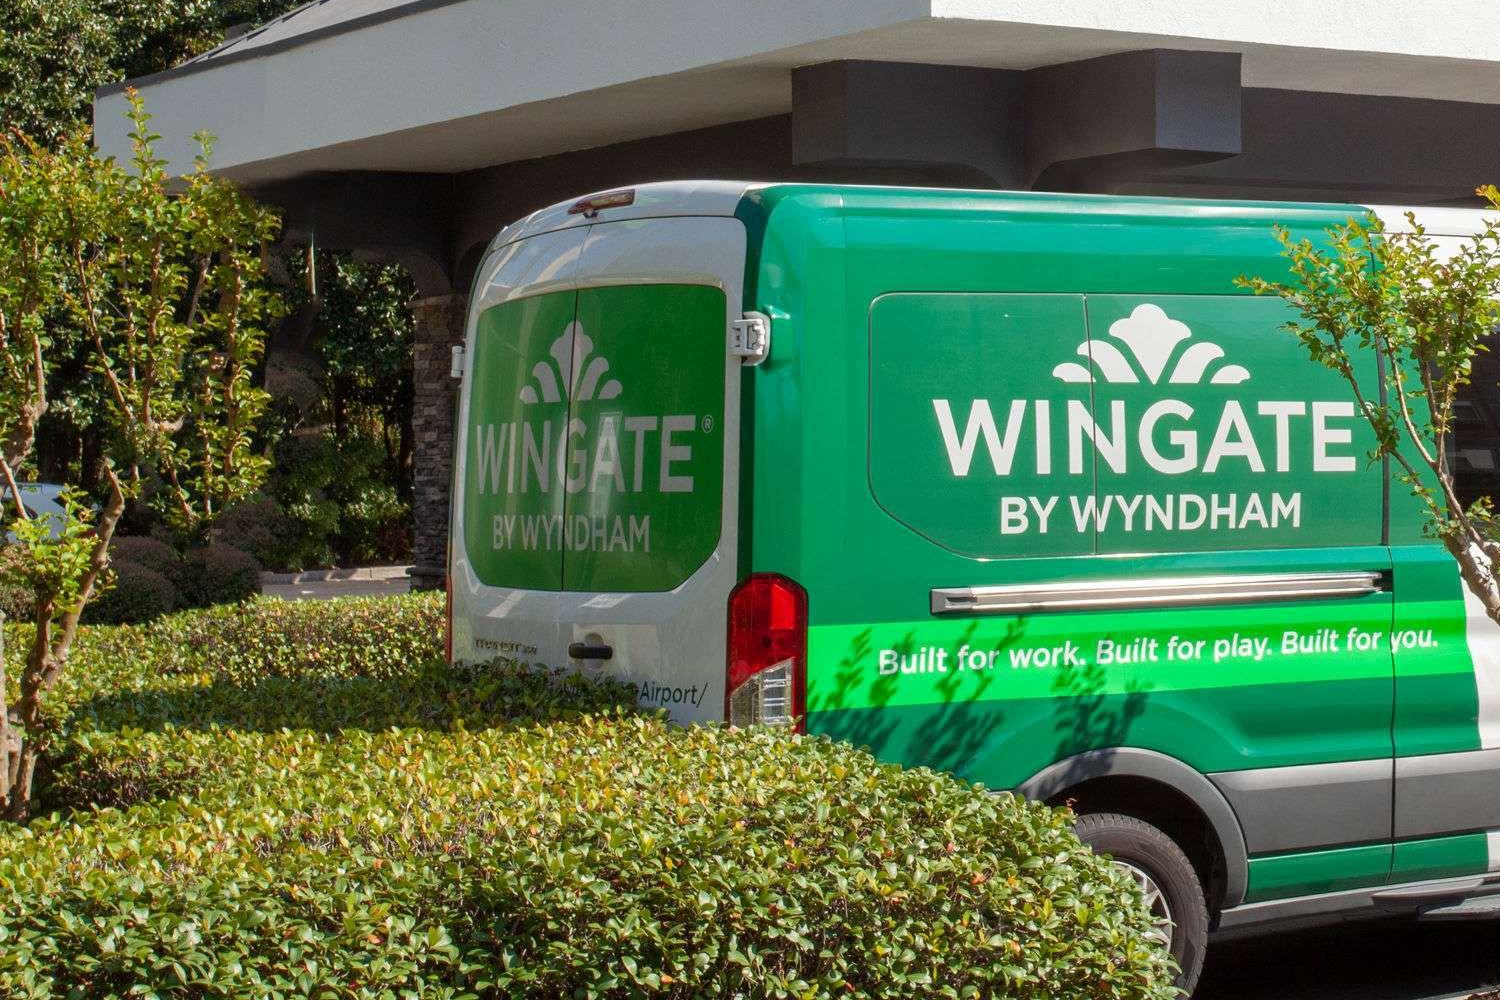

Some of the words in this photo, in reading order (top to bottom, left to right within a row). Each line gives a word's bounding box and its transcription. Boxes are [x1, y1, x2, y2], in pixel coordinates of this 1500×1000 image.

[933, 398, 1358, 477] WINGATE
[492, 514, 516, 551] BY
[523, 514, 651, 553] WYNDHAM
[1000, 495, 1059, 536] BY
[1069, 492, 1302, 534] WYNDHAM
[878, 645, 948, 676] Built
[956, 644, 1000, 672] for
[1009, 640, 1087, 670] work.
[1096, 637, 1159, 665] Built
[1167, 633, 1206, 661] for
[1213, 632, 1273, 663] play.
[1280, 629, 1340, 655] Built
[1346, 627, 1383, 651] for
[1390, 628, 1439, 655] you.
